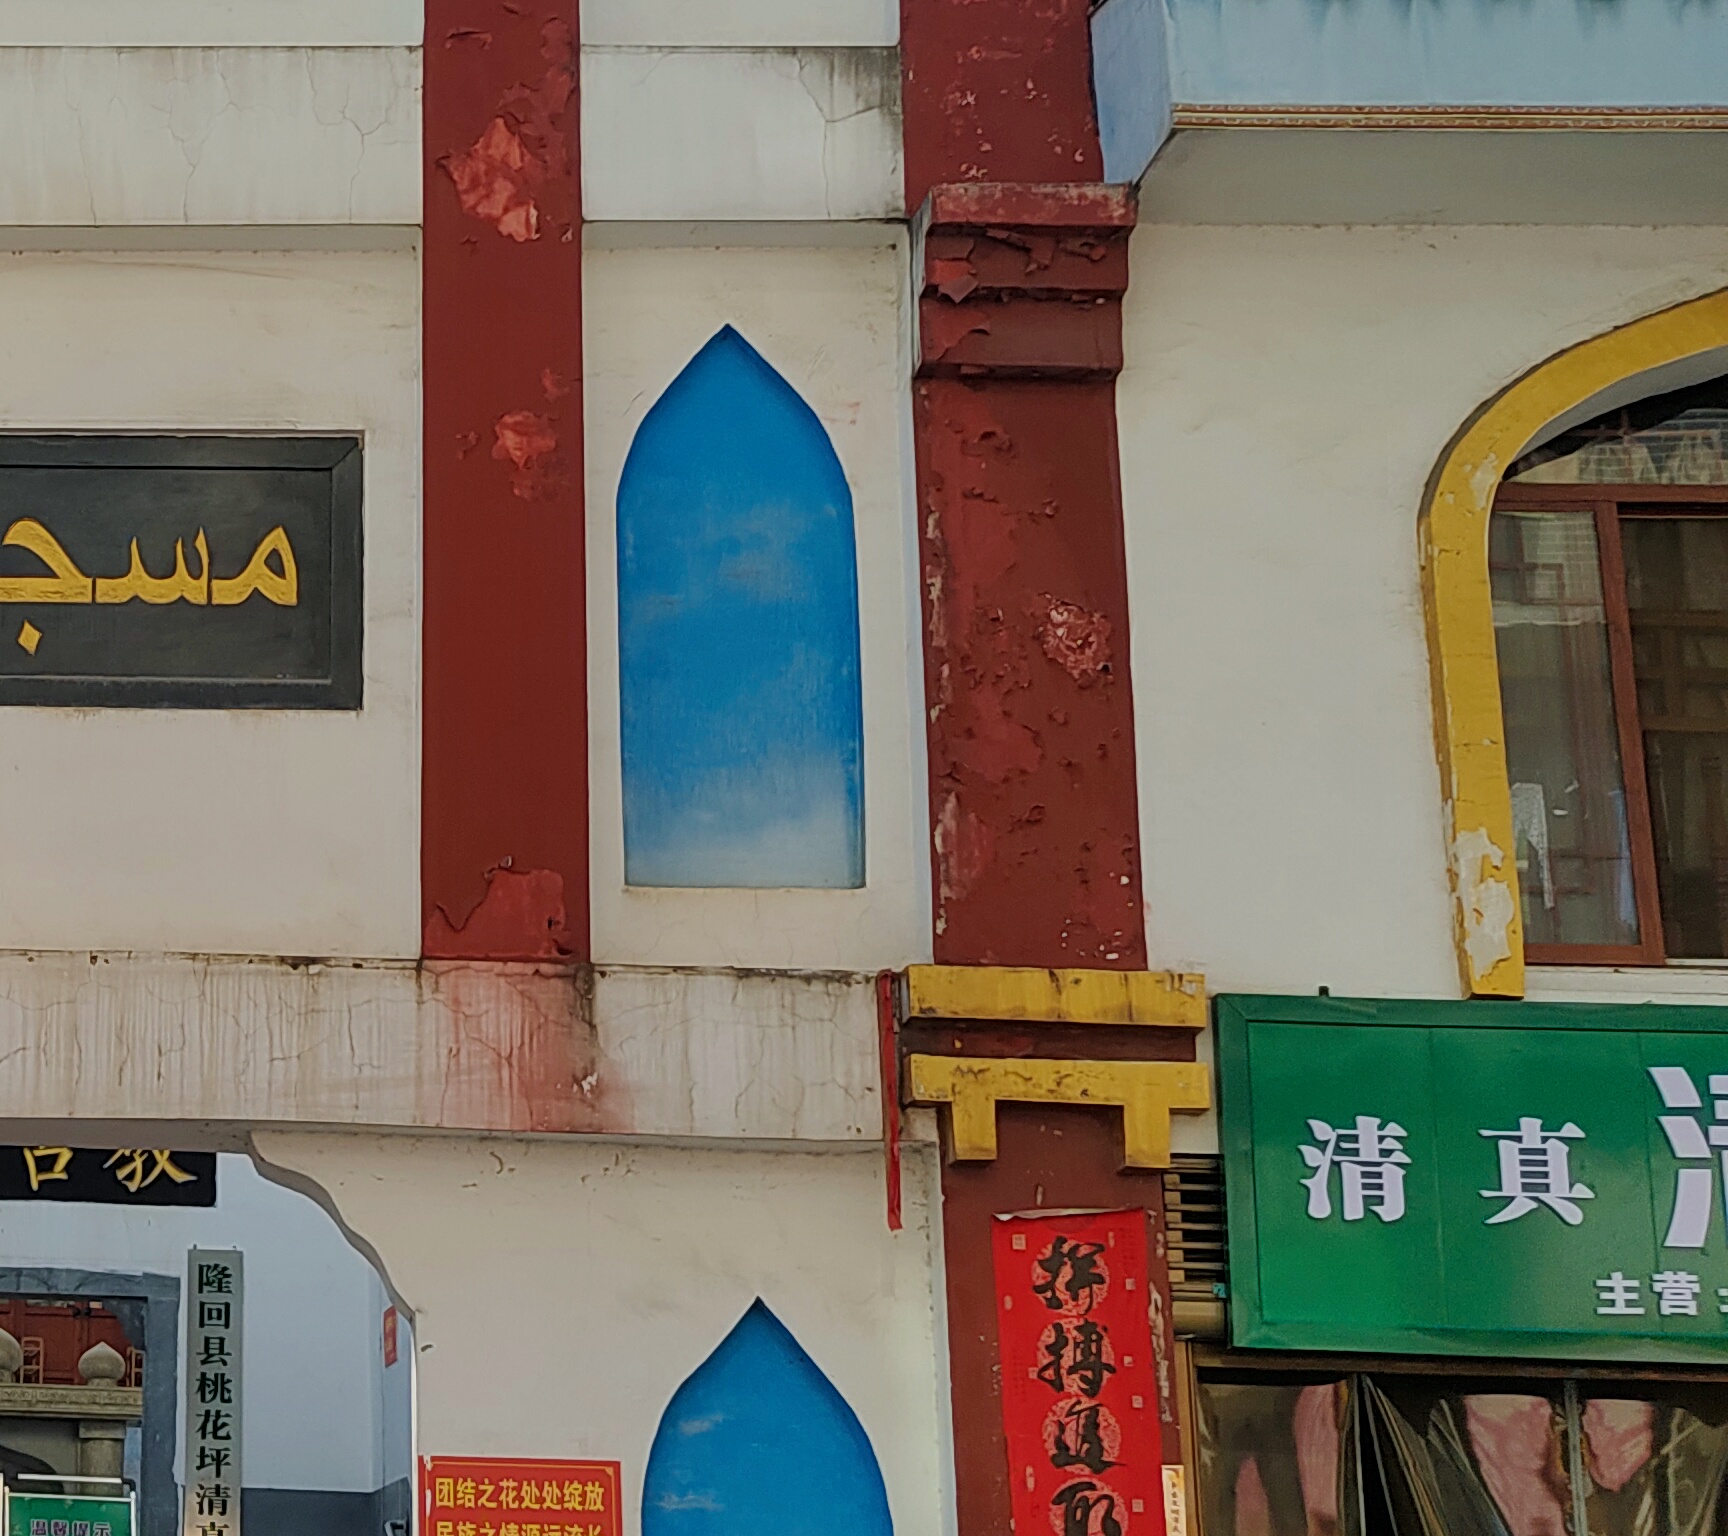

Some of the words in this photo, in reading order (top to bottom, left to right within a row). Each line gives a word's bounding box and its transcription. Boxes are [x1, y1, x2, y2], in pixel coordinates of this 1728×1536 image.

[1297, 1114, 1596, 1226] 清真
[1595, 1270, 1728, 1316] 主营
[435, 1477, 605, 1512] 团结之花处处绽放
